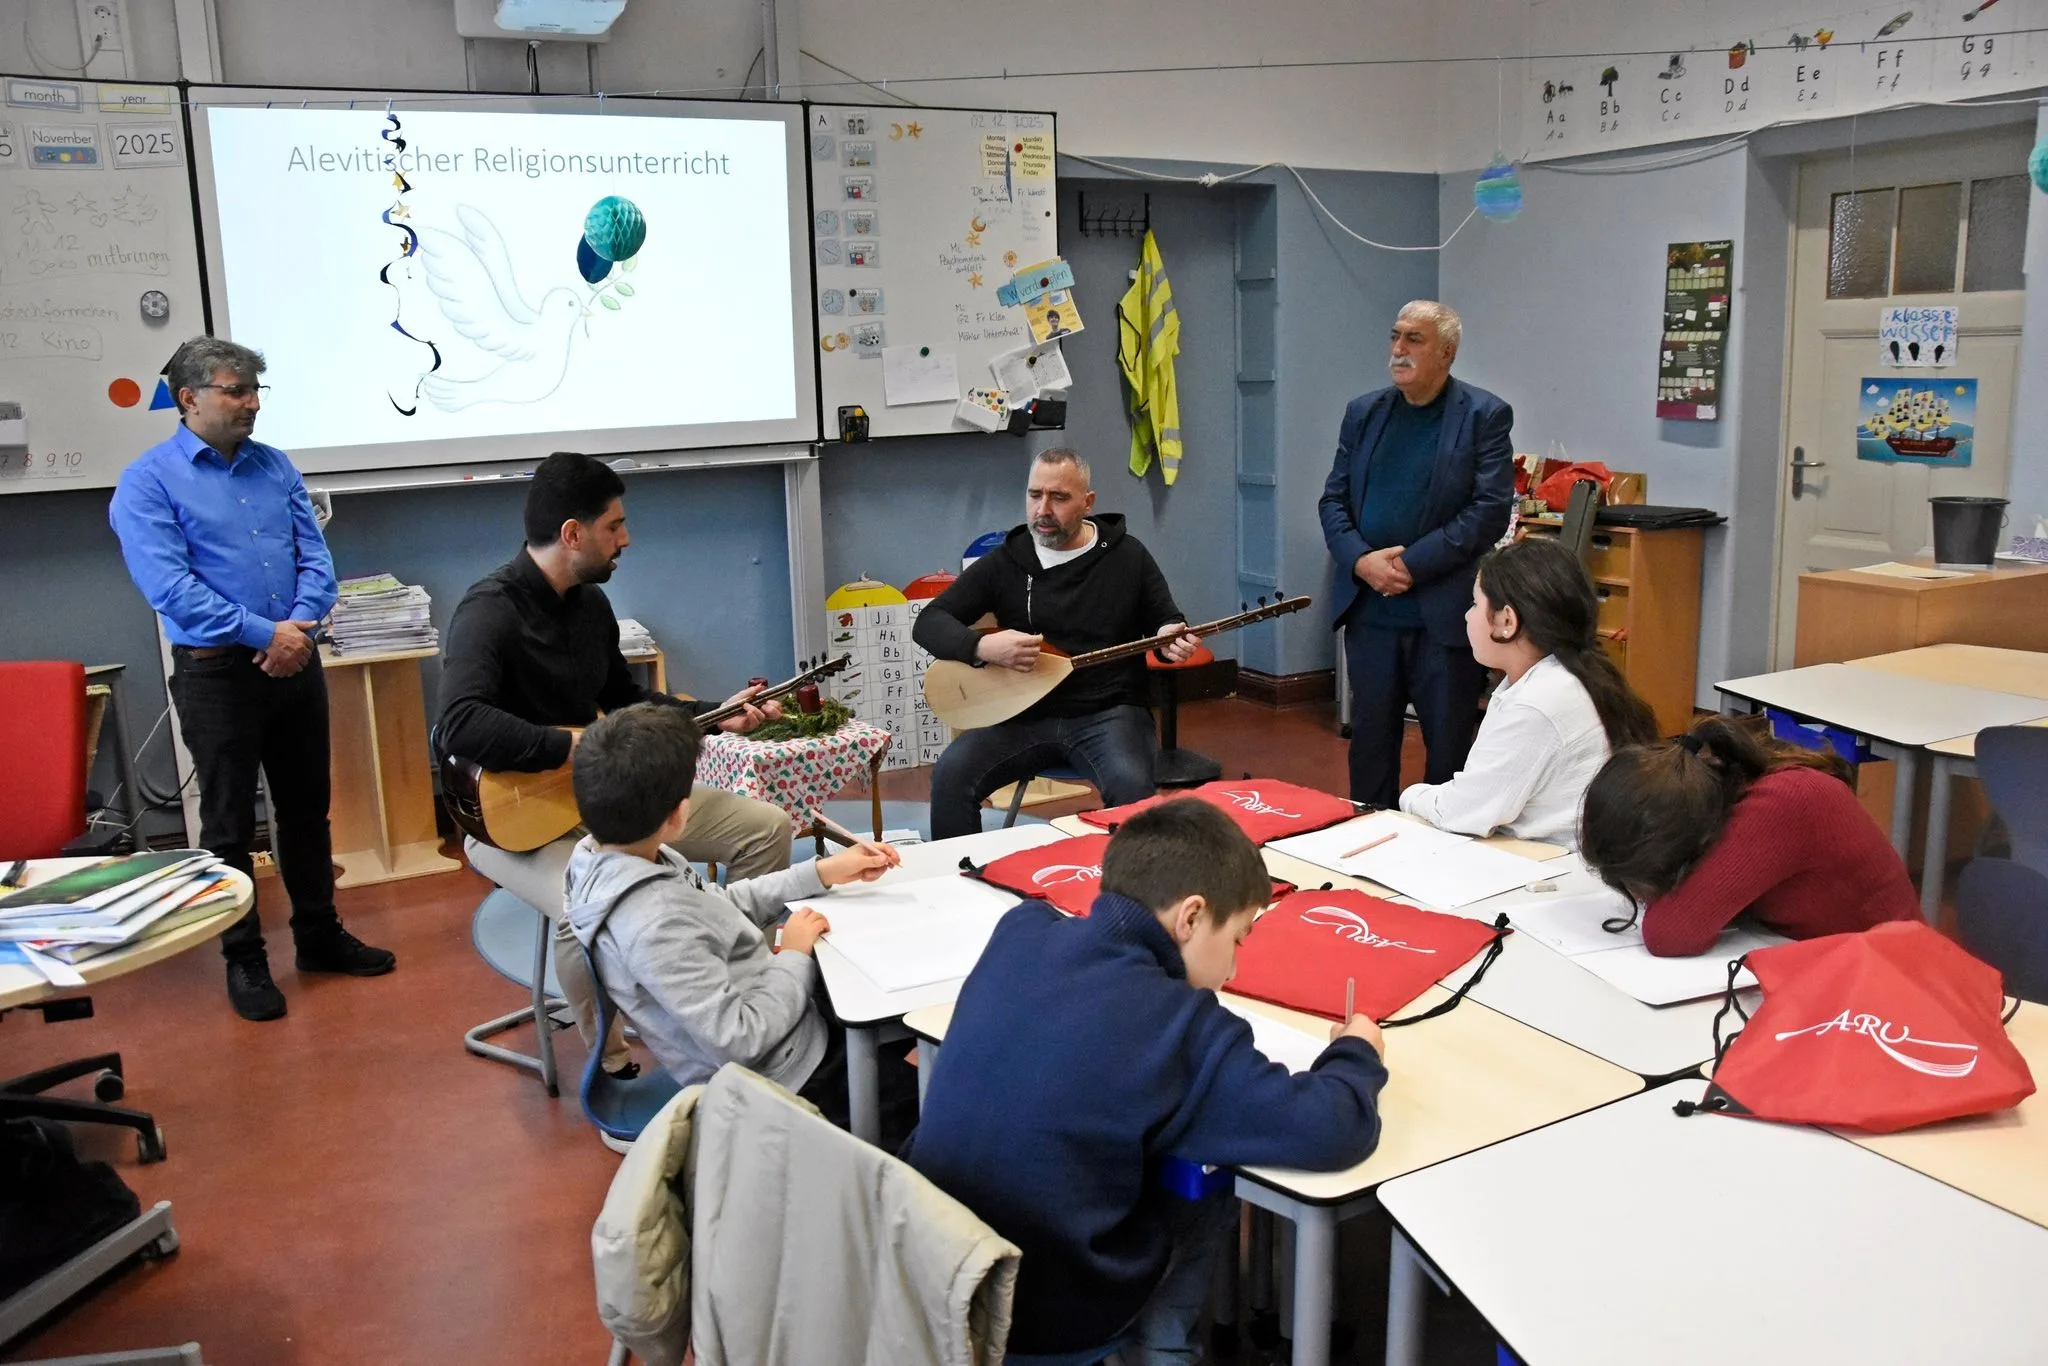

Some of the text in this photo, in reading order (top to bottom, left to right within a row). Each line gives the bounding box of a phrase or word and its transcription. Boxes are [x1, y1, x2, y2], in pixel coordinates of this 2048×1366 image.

[24, 90, 65, 102] month
[121, 94, 147, 109] year
[818, 114, 827, 126] A
[32, 129, 93, 145] November
[116, 133, 175, 155] 2025
[287, 145, 731, 178] Alevitischer Religionsunterricht
[87, 244, 171, 270] mitbringen
[41, 331, 90, 352] Kino
[47, 452, 57, 467] 9
[64, 451, 82, 466] 10
